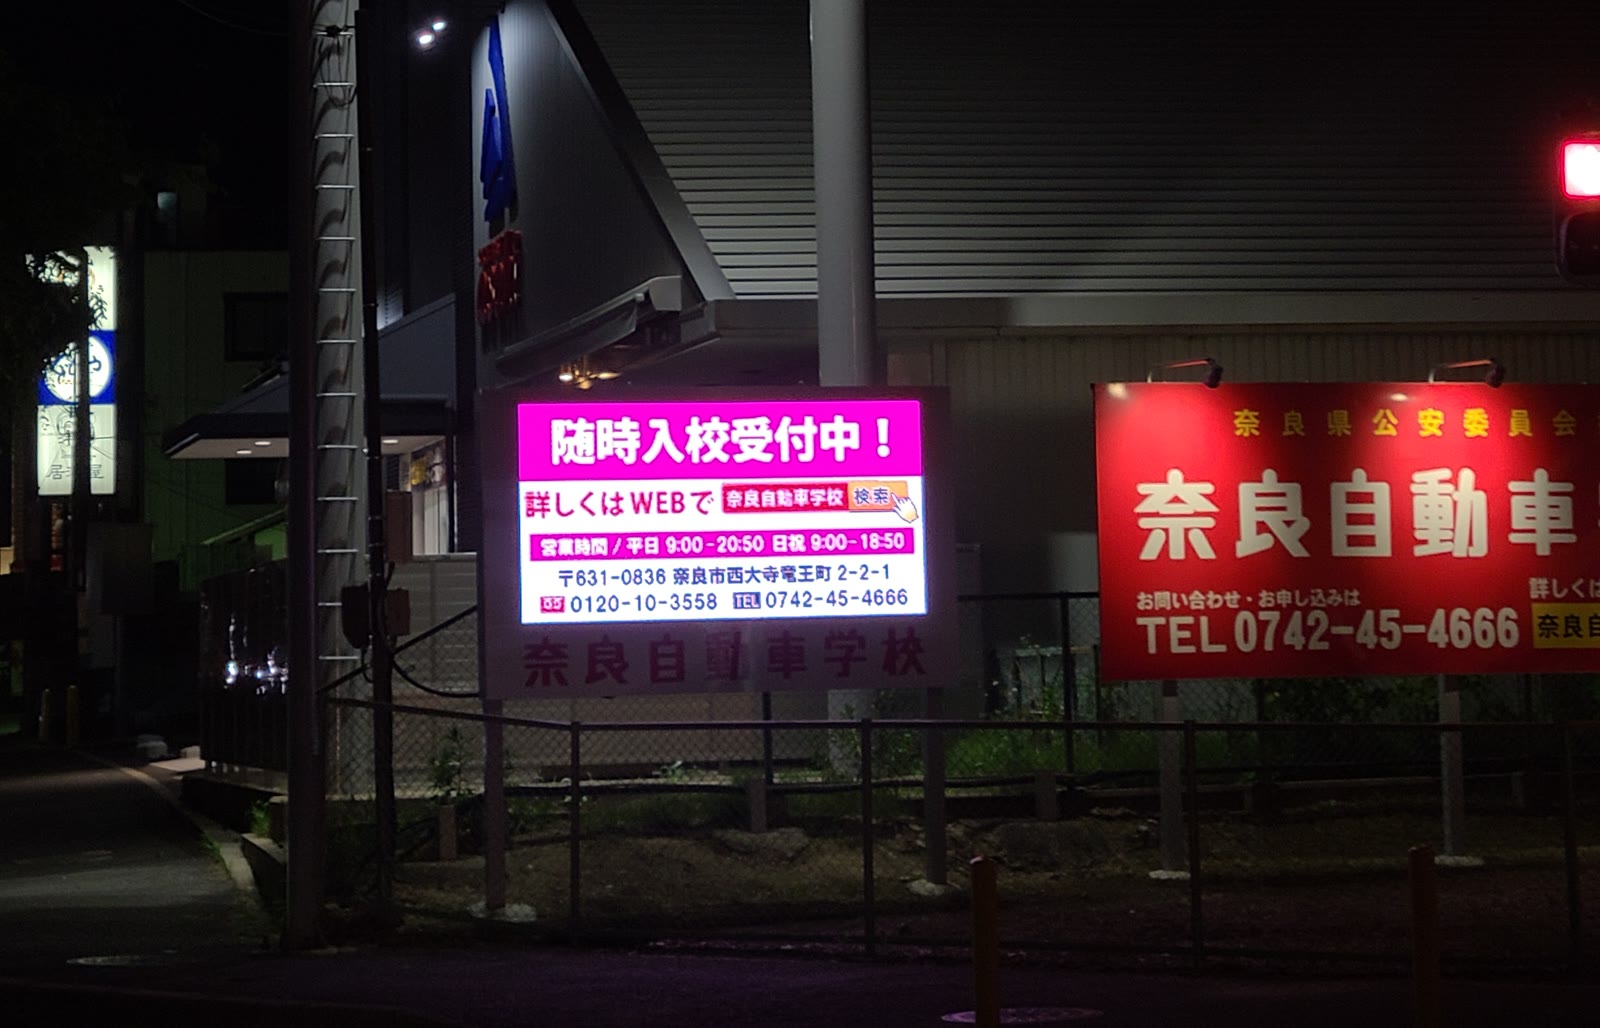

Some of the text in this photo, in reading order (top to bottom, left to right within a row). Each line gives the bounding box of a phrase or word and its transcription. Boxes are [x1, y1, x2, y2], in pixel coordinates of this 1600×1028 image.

[1234, 407, 1600, 438] 奈良県公安委員会
[550, 414, 891, 465] 随時入校受付中！
[726, 487, 845, 508] 奈良自動車学校
[854, 488, 889, 505] 検索
[1134, 467, 1600, 560] 奈良自動車
[772, 533, 807, 552] 日祝
[672, 565, 832, 585] 奈良市西大寺竜王町
[837, 564, 890, 580] 2-2-1
[570, 588, 909, 613] 0120-10-3558 TEL 0742-45-4666
[1136, 588, 1361, 611] お問い合わせ・お申し込みは
[1135, 606, 1519, 655] TEL 0742-45-4666
[523, 625, 928, 688] 奈良自動車学校
